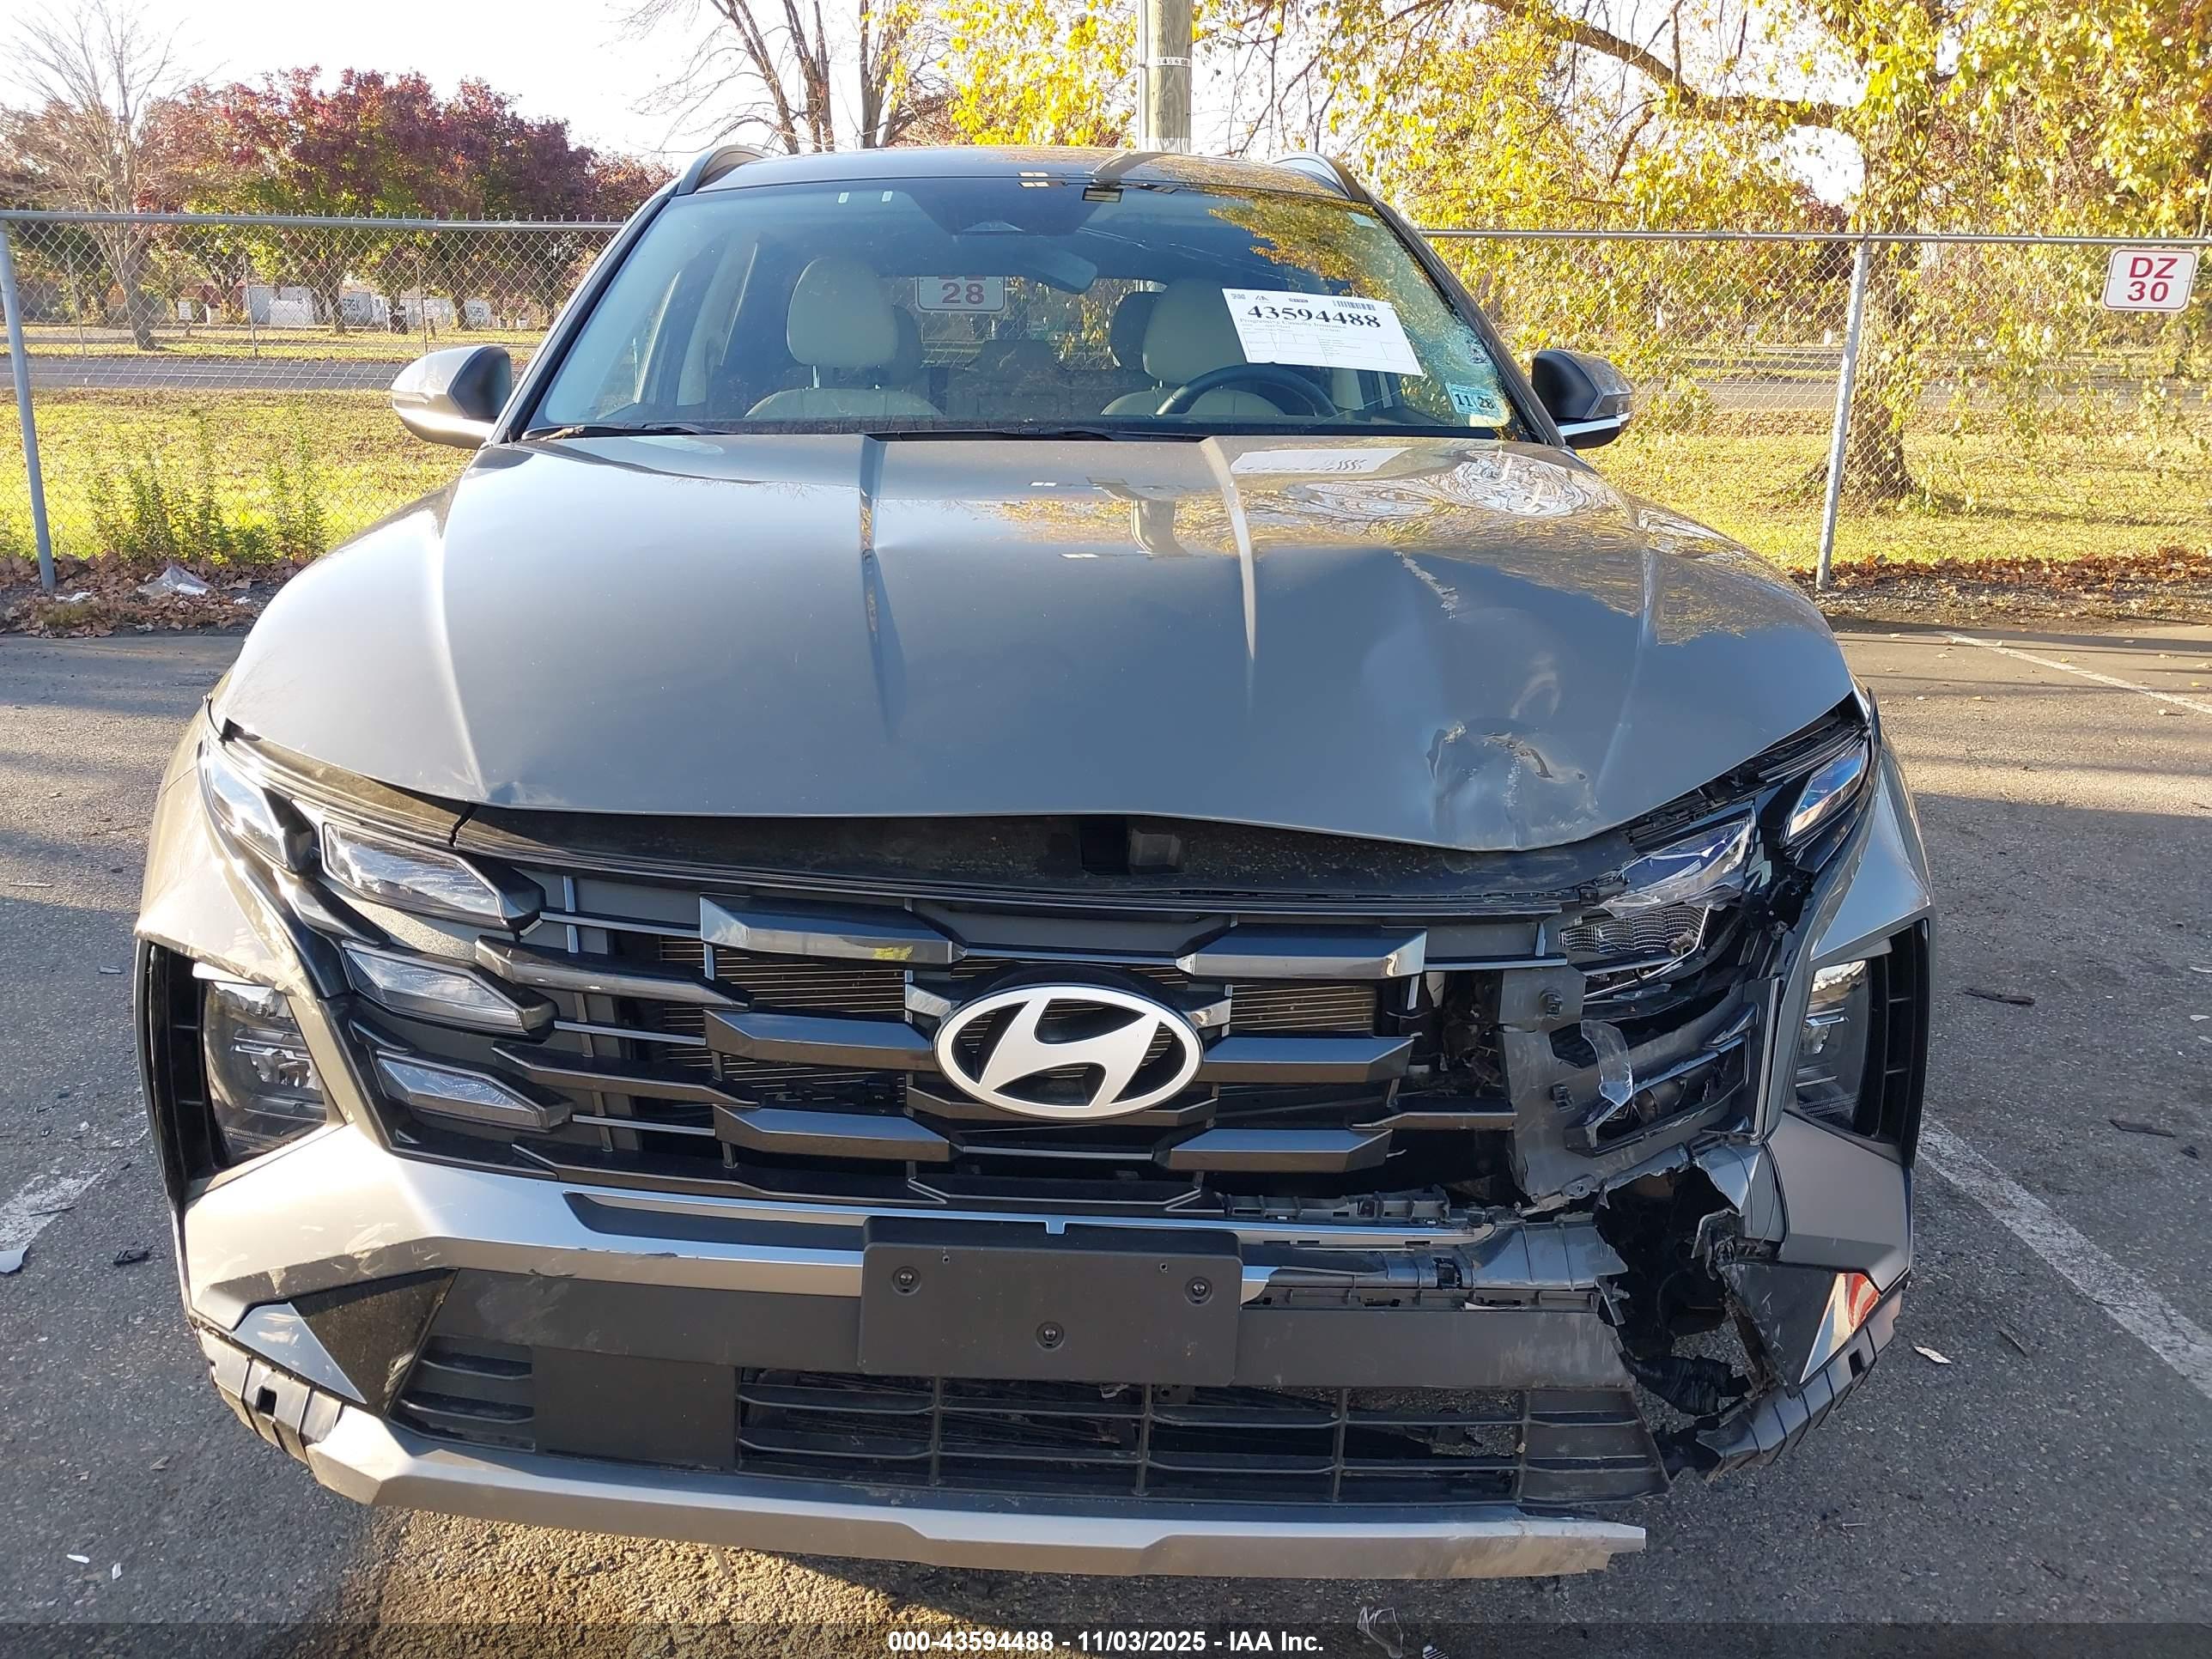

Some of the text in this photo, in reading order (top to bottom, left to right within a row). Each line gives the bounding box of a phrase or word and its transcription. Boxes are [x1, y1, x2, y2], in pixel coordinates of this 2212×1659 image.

[2129, 257, 2179, 279] DZ
[941, 282, 985, 305] 28
[2127, 280, 2169, 302] 30
[1248, 305, 1382, 328] 43594488
[1455, 393, 1474, 407] 11
